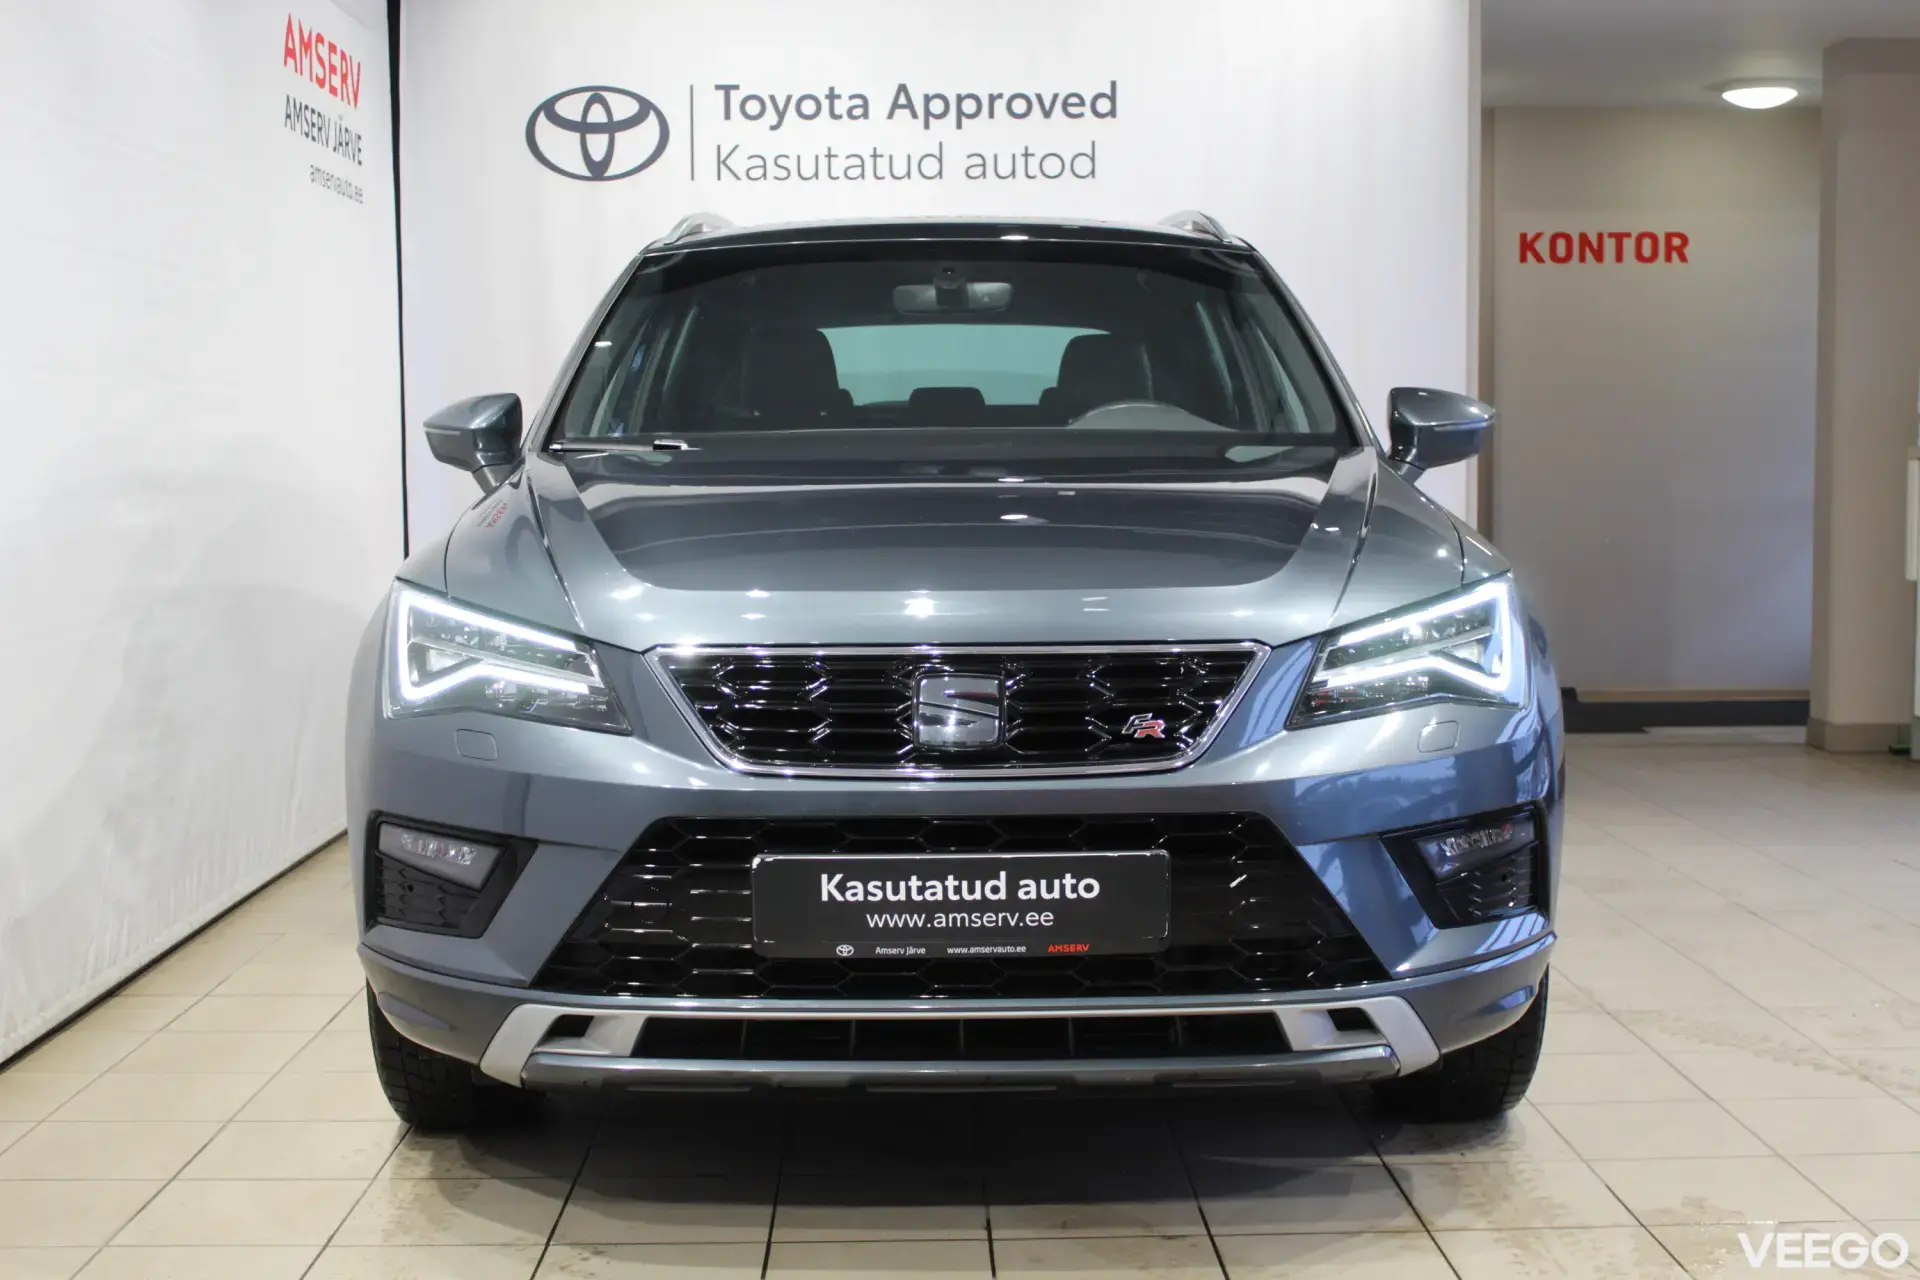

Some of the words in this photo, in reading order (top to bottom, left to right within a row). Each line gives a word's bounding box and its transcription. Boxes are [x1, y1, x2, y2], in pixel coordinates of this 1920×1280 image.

[284, 12, 361, 110] AMSERV
[714, 84, 870, 130] Toyota
[886, 80, 1118, 130] Approved
[284, 94, 331, 149] AMSERV
[332, 114, 362, 166] JÄRVE
[715, 141, 943, 181] Kasutatud
[964, 140, 1097, 181] autod
[309, 164, 364, 204] amservauto.ee
[1519, 231, 1690, 264] KONTOR
[1121, 712, 1166, 739] FR
[820, 871, 1007, 902] Kasutatud
[1017, 873, 1101, 900] auto
[866, 908, 1054, 928] www.amserv.ee
[875, 946, 905, 955] Amserv
[947, 944, 1027, 954] www.amservauto.ee
[1047, 944, 1090, 953] AMSERV
